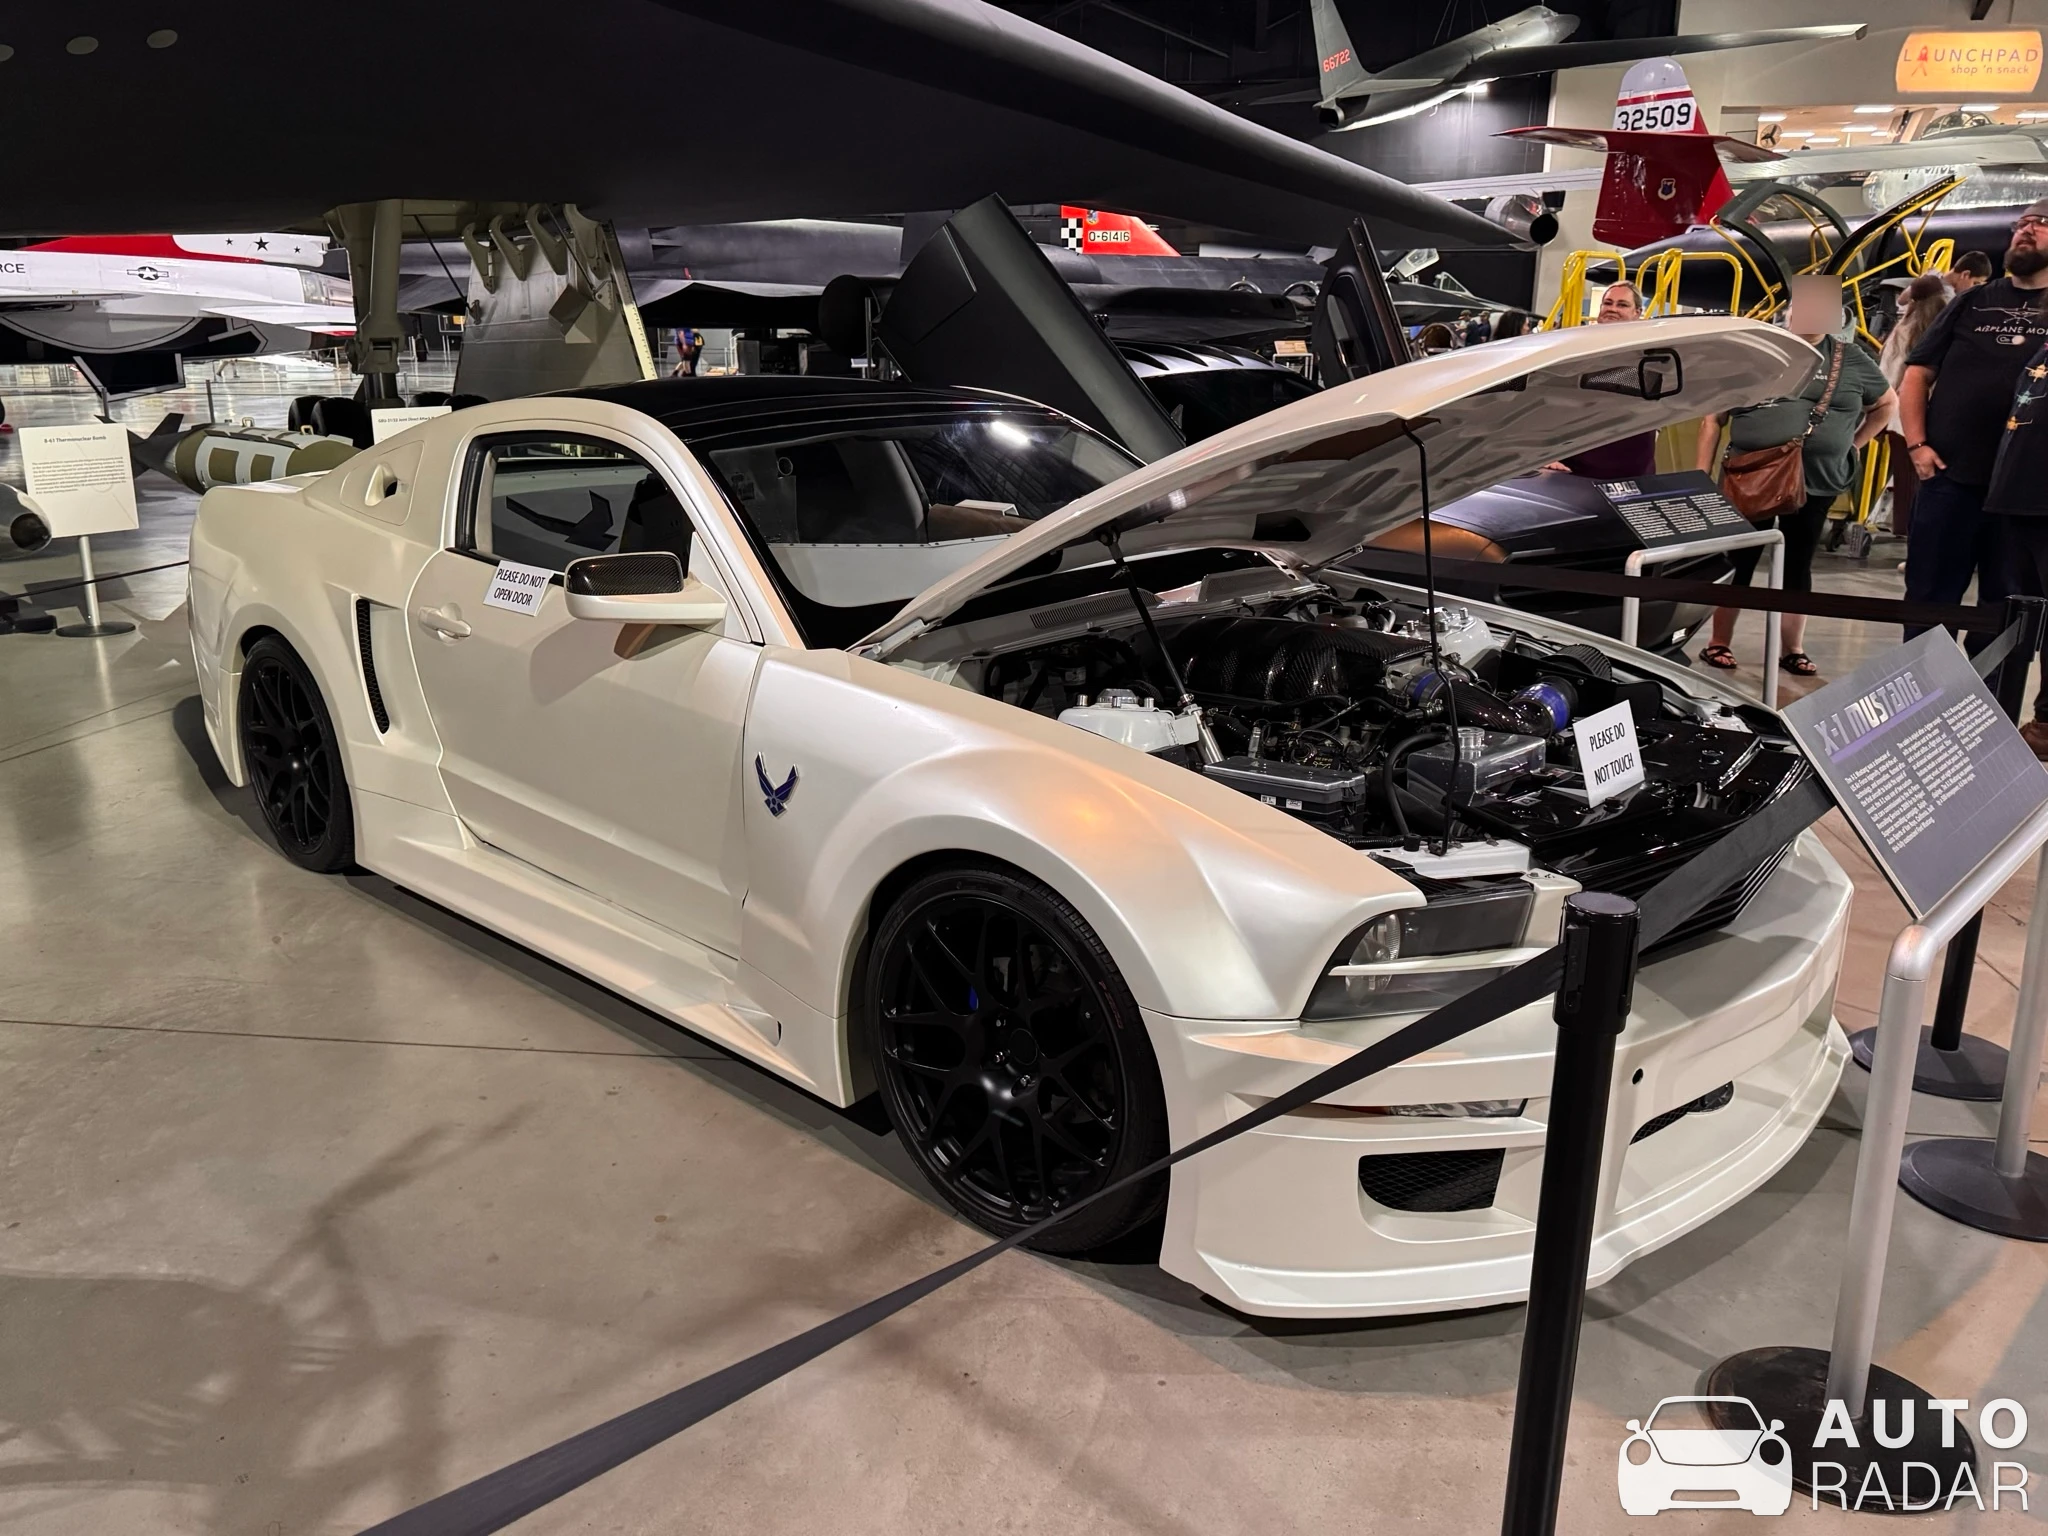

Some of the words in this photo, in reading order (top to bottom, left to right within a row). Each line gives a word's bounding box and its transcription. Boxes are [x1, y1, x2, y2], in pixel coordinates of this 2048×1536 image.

[1323, 48, 1351, 73] 66722
[1903, 45, 2039, 64] LAUNCHPAD
[1951, 65, 1978, 76] shop
[1997, 65, 2030, 74] snack
[1617, 103, 1691, 131] 32509
[1974, 324, 2024, 334] AIRPLANE
[2026, 327, 2048, 336] MO
[495, 568, 519, 583] PLEASE
[518, 573, 530, 585] DO
[529, 575, 546, 589] NOT
[494, 587, 513, 602] OPEN
[511, 592, 533, 606] DOOR
[1589, 726, 1615, 751] PLEASE
[1613, 722, 1626, 740] DO
[1813, 713, 1851, 756] X-1
[1594, 763, 1611, 787] NOT
[1609, 752, 1635, 777] TOUCH
